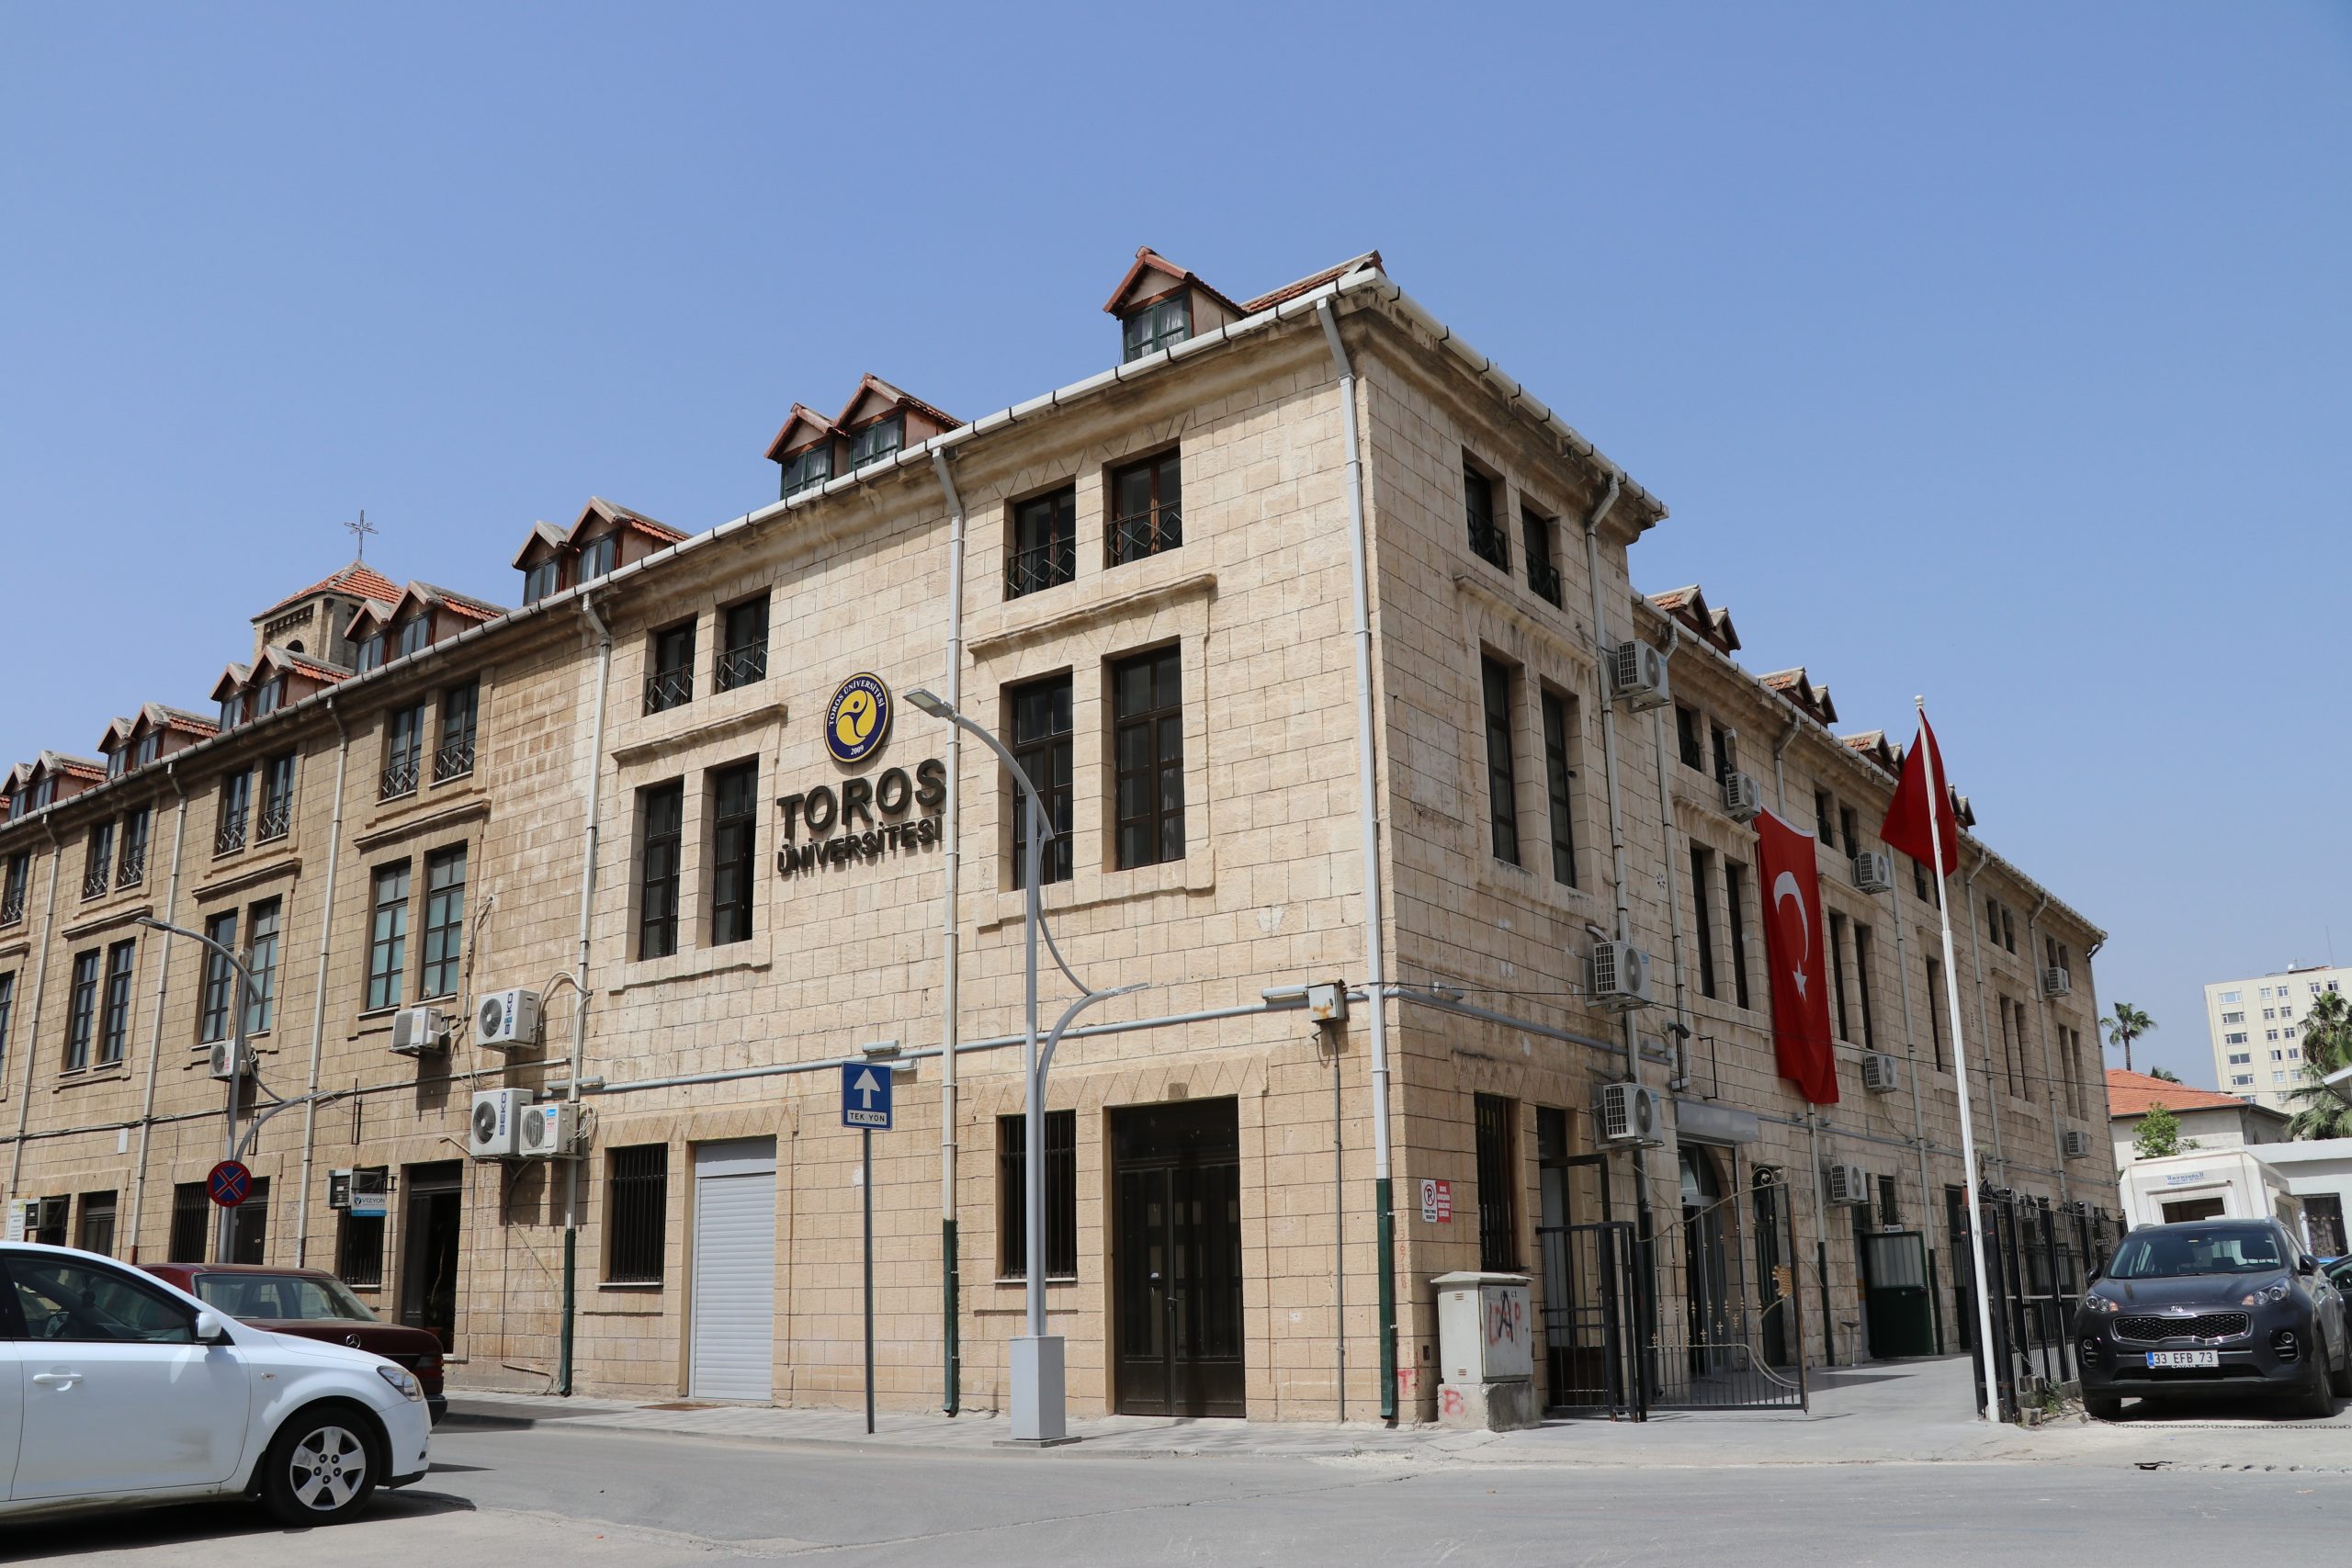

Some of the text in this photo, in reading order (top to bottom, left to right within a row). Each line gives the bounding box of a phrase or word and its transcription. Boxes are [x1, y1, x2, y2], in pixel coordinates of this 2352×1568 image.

[829, 694, 843, 727] TOROS
[850, 745, 865, 755] 2009
[776, 759, 946, 840] TOROS
[777, 808, 943, 873] ÜNİVERSİTESİ
[504, 993, 514, 1035] BKO
[499, 1092, 507, 1136] BEKO
[850, 1112, 885, 1122] TEK YÖN
[2154, 1352, 2213, 1364] 33 EFB 73
